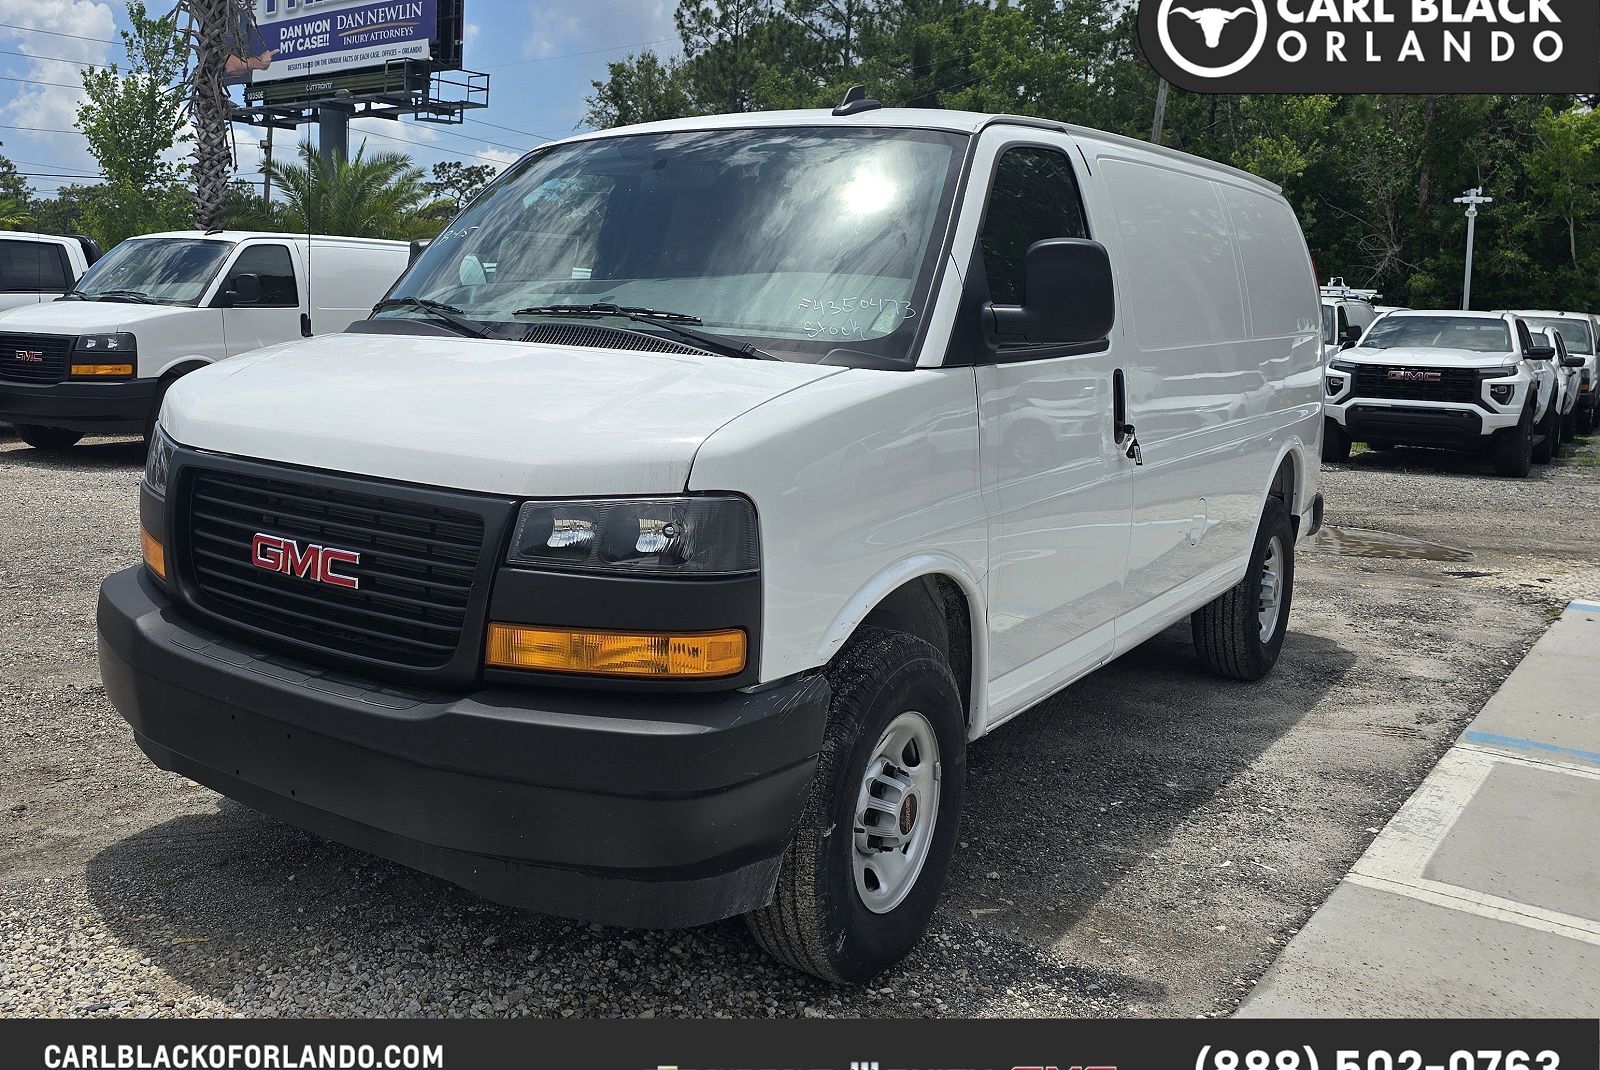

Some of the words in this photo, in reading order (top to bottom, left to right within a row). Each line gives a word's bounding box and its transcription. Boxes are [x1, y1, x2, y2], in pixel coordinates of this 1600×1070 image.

[337, 12, 365, 30] DAN
[367, 1, 423, 25] NEWLIN
[280, 25, 302, 40] DAN
[304, 18, 331, 36] WON
[343, 33, 369, 45] INJURY
[370, 26, 414, 41] ATTORNEYS
[280, 40, 295, 54] MY
[296, 33, 330, 51] CASE!!
[402, 46, 422, 54] ORLANDO
[15, 350, 43, 362] GMC
[1387, 370, 1441, 382] GMC
[251, 532, 360, 589] GMC
